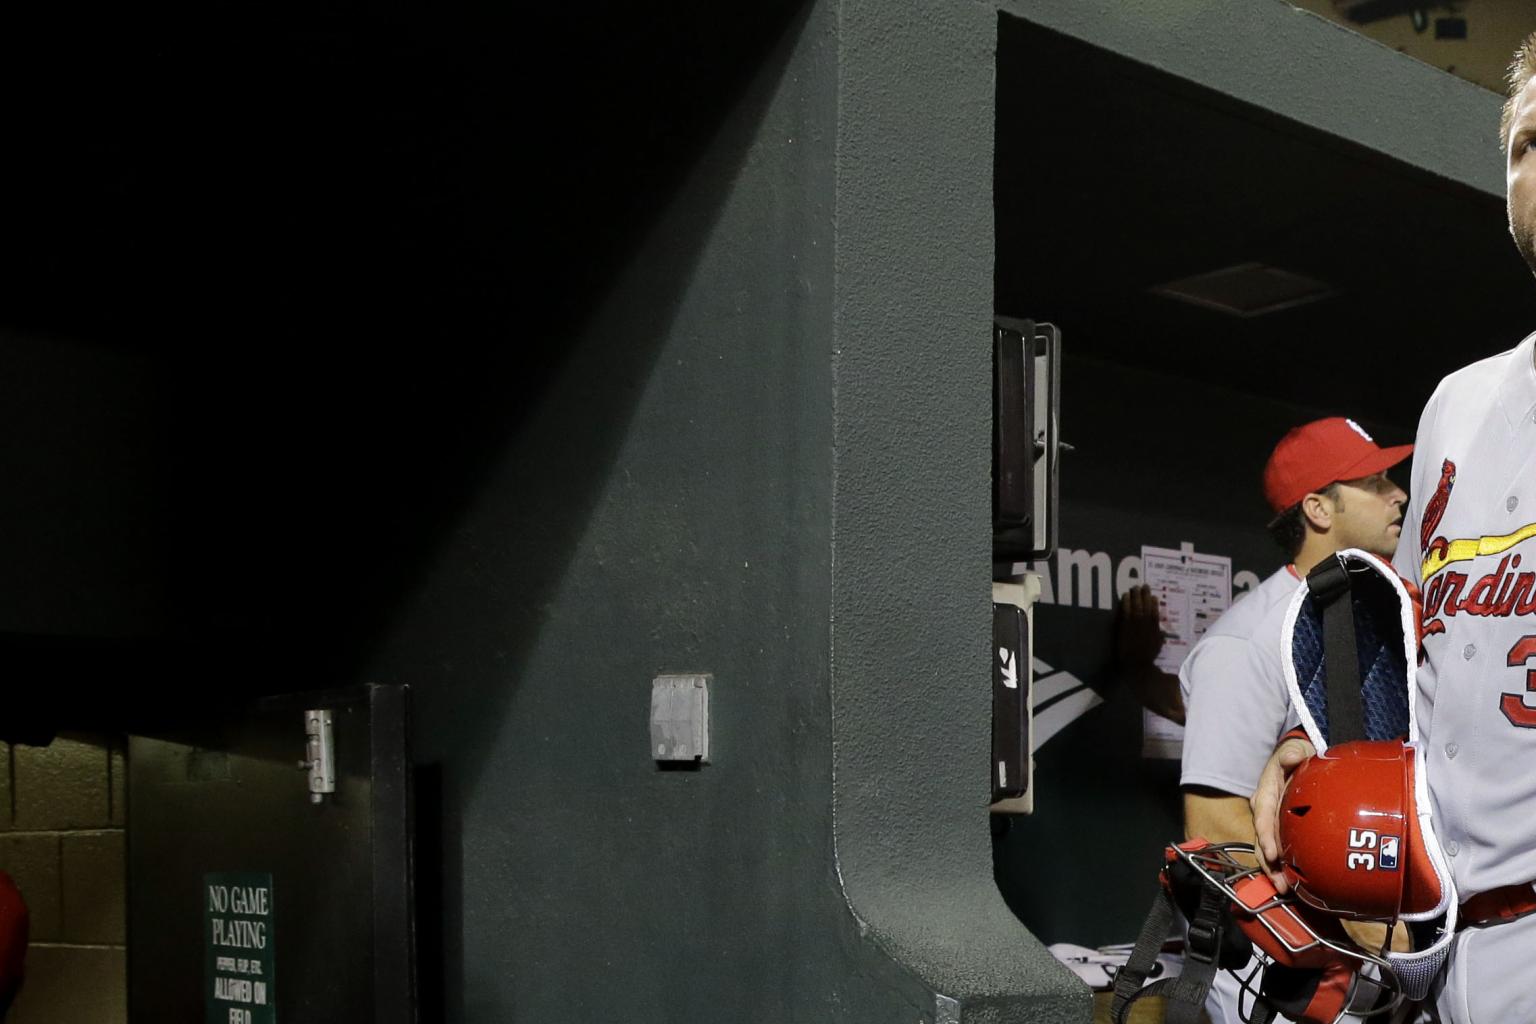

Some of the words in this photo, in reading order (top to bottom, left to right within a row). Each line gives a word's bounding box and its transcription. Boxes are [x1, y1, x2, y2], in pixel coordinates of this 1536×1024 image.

[1347, 829, 1377, 871] 35
[208, 885, 229, 913] NO
[230, 886, 269, 916] GAME
[212, 918, 267, 949] PLAYING
[214, 976, 253, 1003] ALLOWED
[253, 980, 267, 1005] ON
